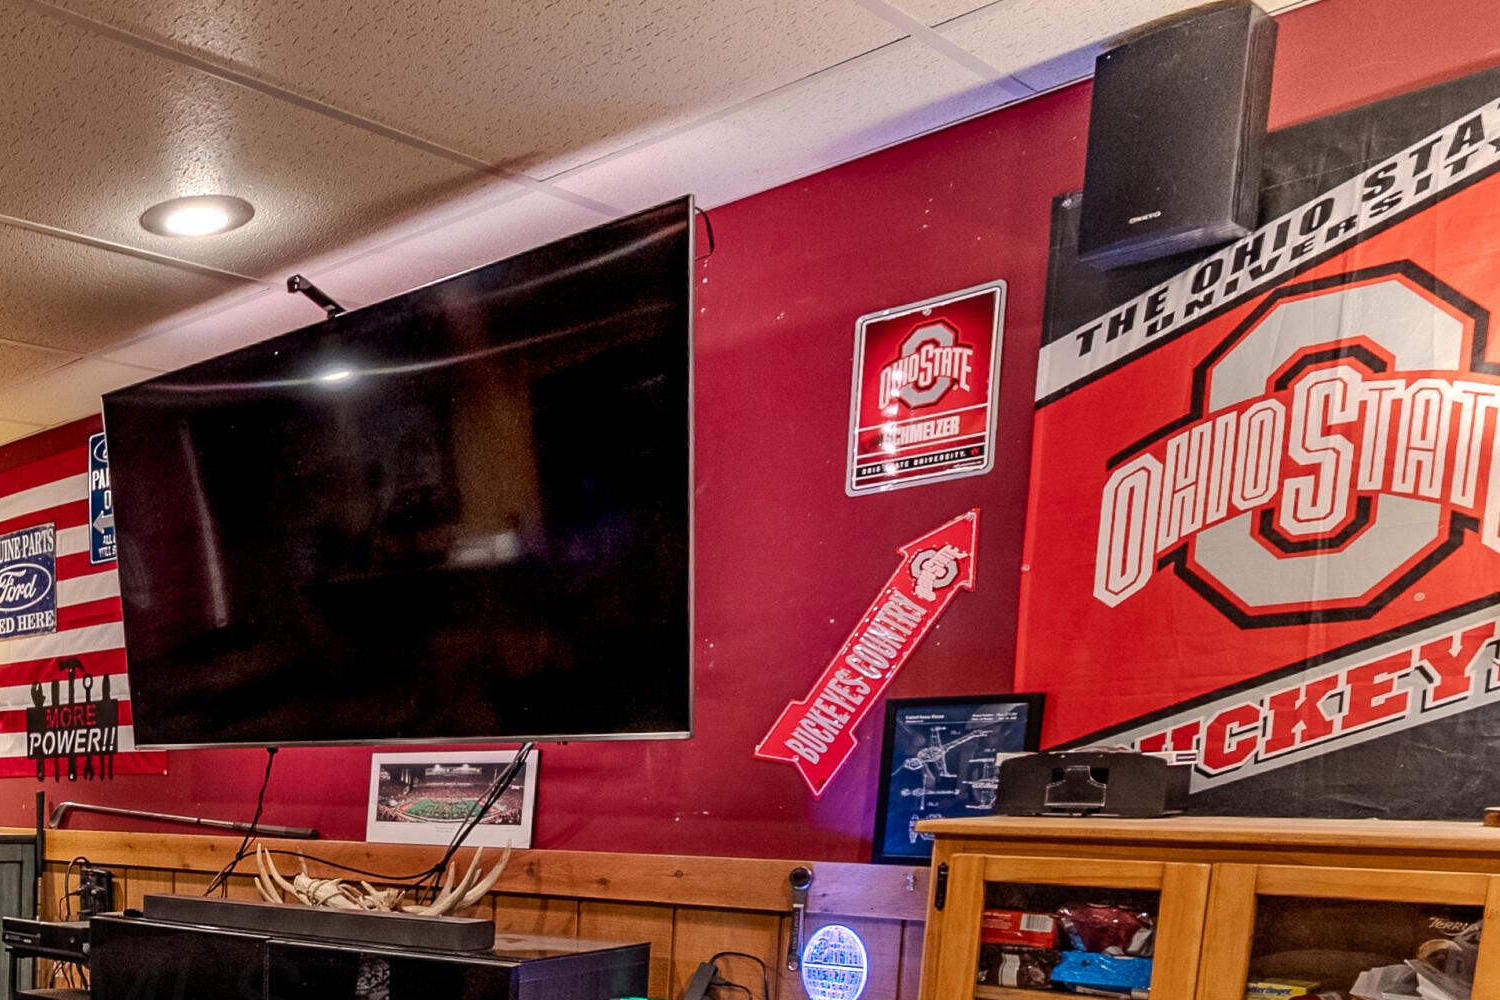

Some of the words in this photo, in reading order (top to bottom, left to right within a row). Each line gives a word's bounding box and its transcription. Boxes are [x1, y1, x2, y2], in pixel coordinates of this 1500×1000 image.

[1076, 286, 1168, 357] THE
[1191, 196, 1336, 295] OHIO
[1362, 103, 1500, 206] STA
[1092, 398, 1287, 608] OHIO
[22, 527, 54, 558] PARTS
[17, 609, 55, 632] HERE
[784, 668, 872, 766] BUCKEYES
[844, 587, 928, 680] COUNTRY
[46, 703, 97, 728] MORE
[28, 726, 117, 756] POWER!!
